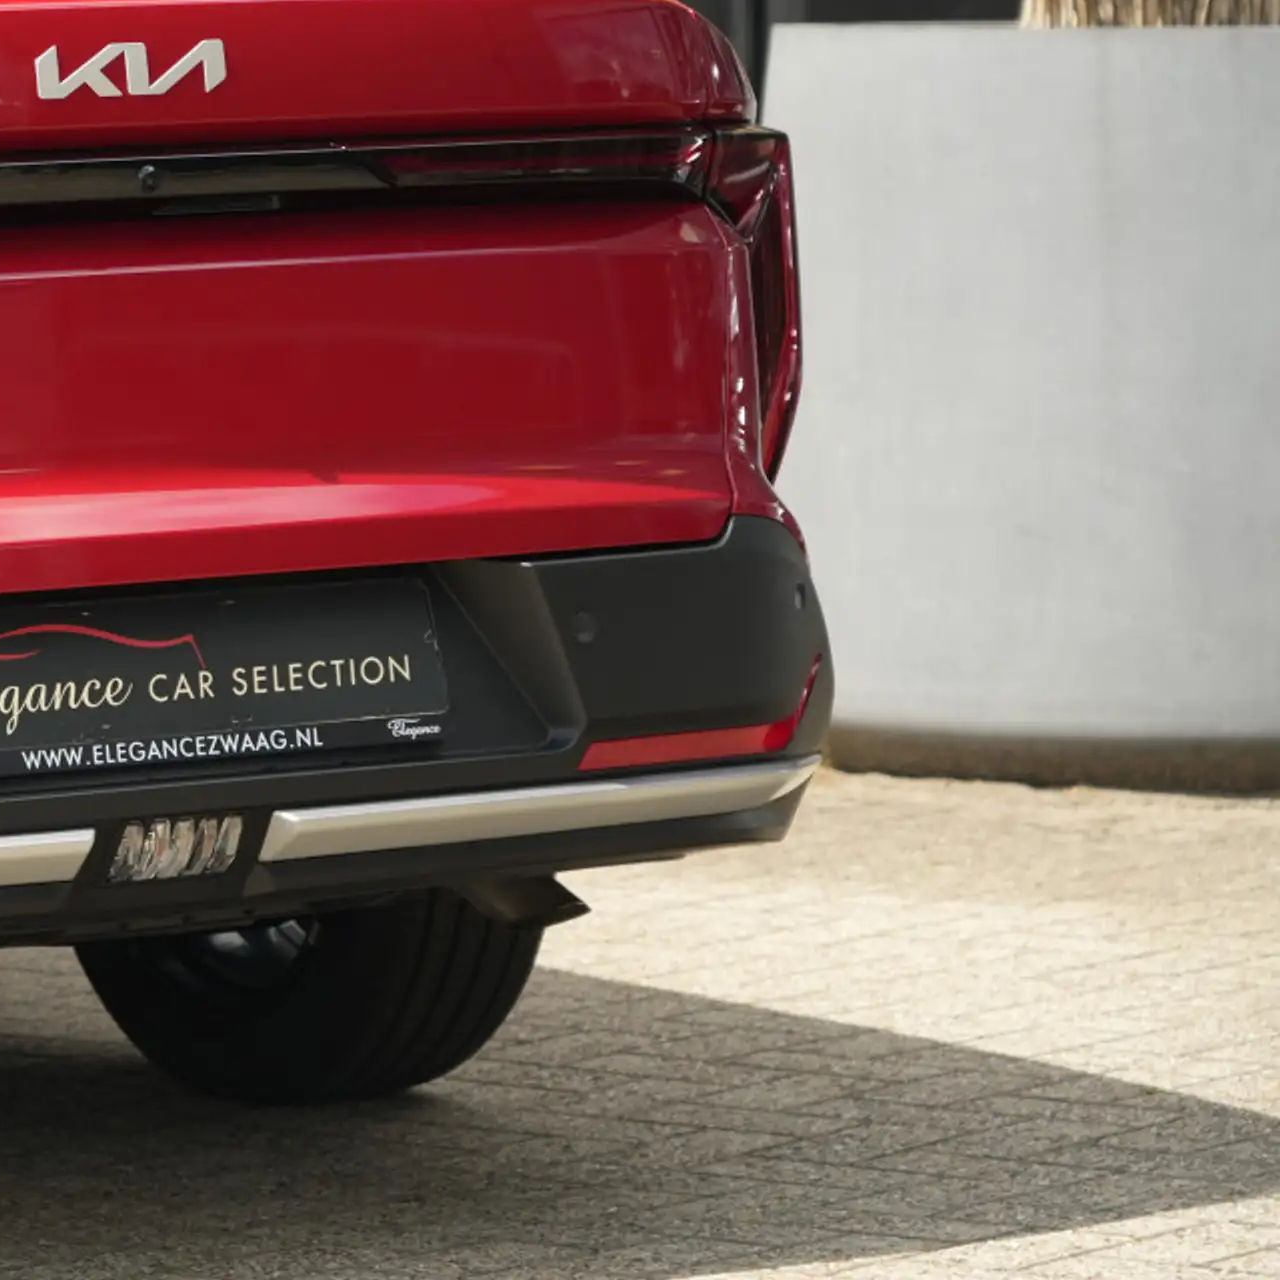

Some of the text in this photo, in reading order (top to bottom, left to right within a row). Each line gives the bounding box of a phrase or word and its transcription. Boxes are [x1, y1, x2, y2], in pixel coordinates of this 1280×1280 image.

[34, 38, 228, 100] KIA
[148, 670, 216, 704] CAR
[232, 654, 412, 697] SELECTION
[21, 727, 324, 771] WWW.ELEGANCEZWAAG.NL
